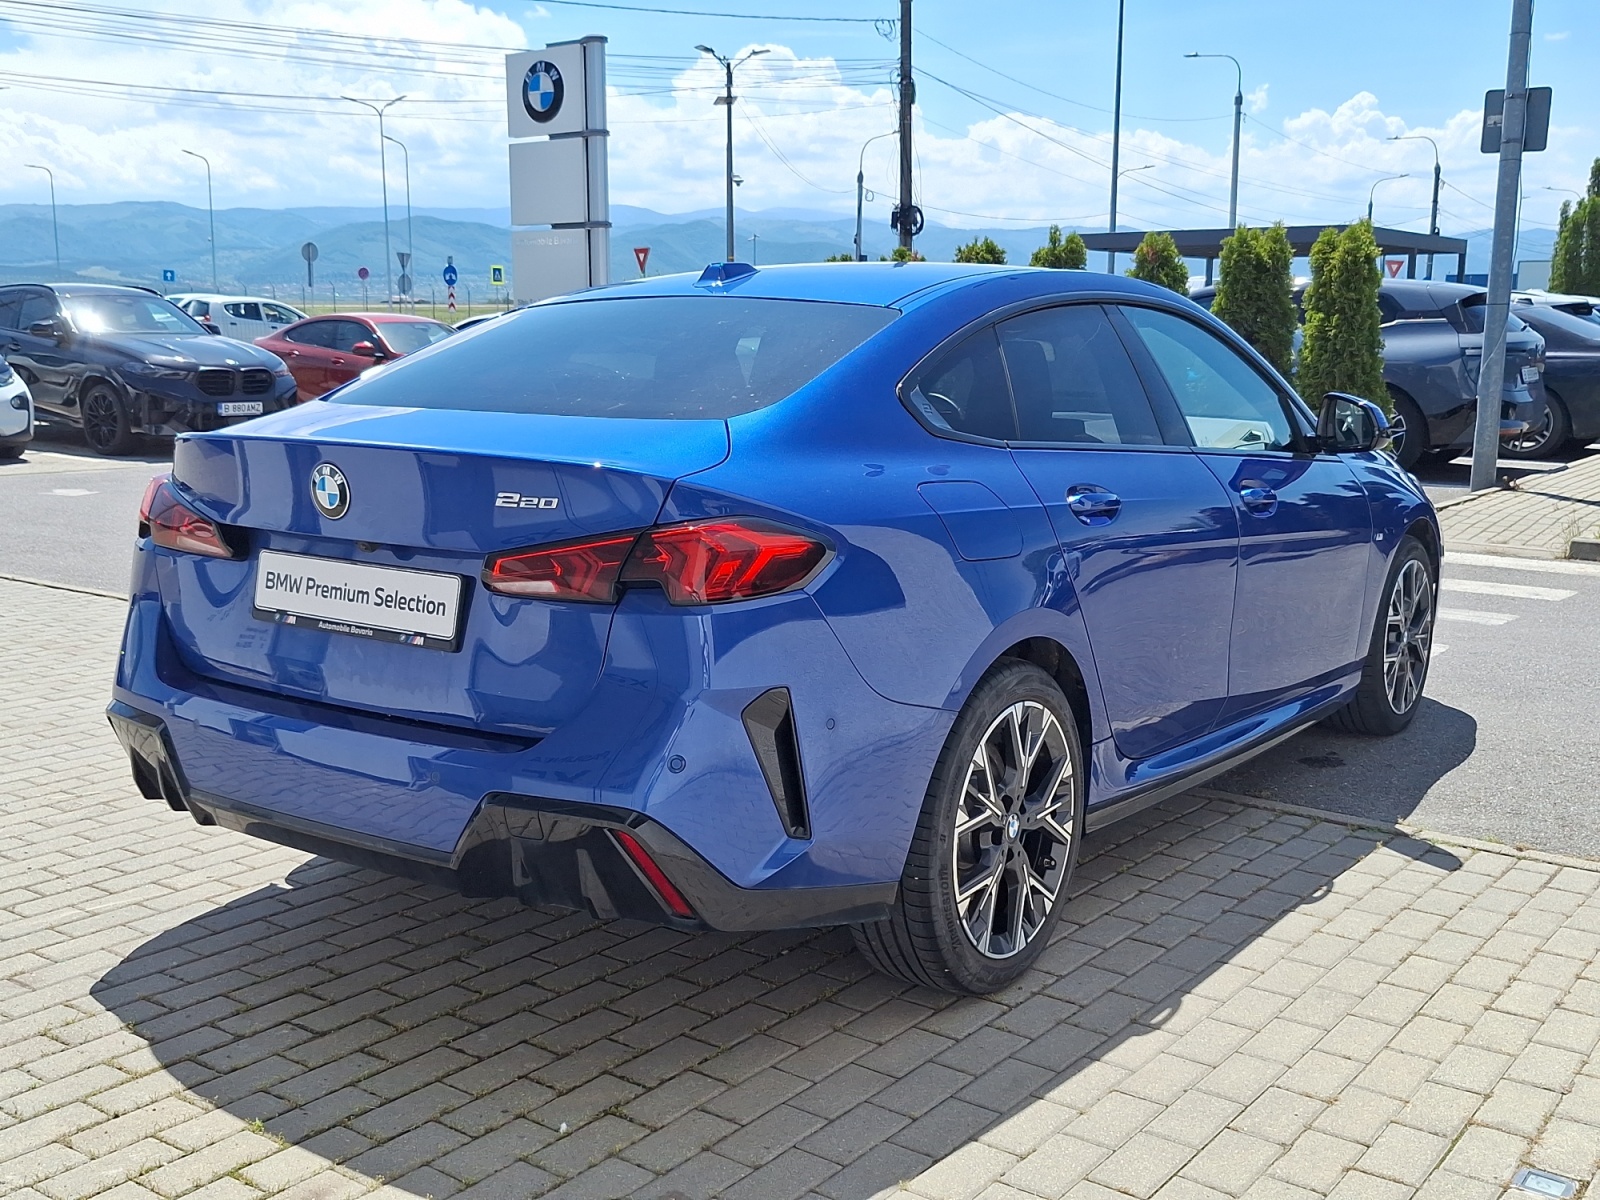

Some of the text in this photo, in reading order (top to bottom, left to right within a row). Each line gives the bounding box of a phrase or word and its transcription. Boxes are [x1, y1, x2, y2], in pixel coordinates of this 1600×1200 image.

[495, 492, 559, 509] 220
[265, 571, 447, 616] BMW Premium Selection
[318, 621, 373, 636] Automobile Bavaria
